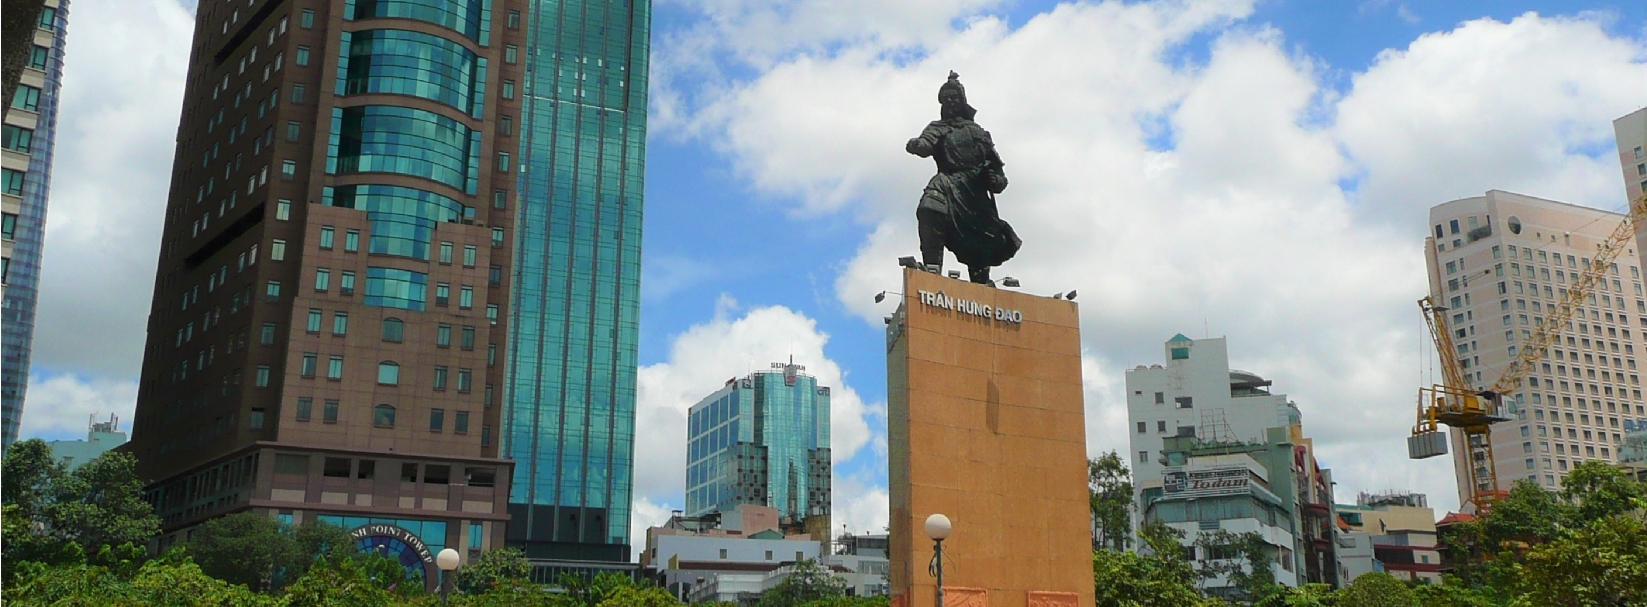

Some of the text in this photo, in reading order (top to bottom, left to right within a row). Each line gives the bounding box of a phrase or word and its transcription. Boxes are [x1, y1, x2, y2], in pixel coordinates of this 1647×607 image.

[995, 307, 1023, 325] ĐẠO
[371, 525, 401, 536] POINT
[403, 531, 433, 563] TOWER
